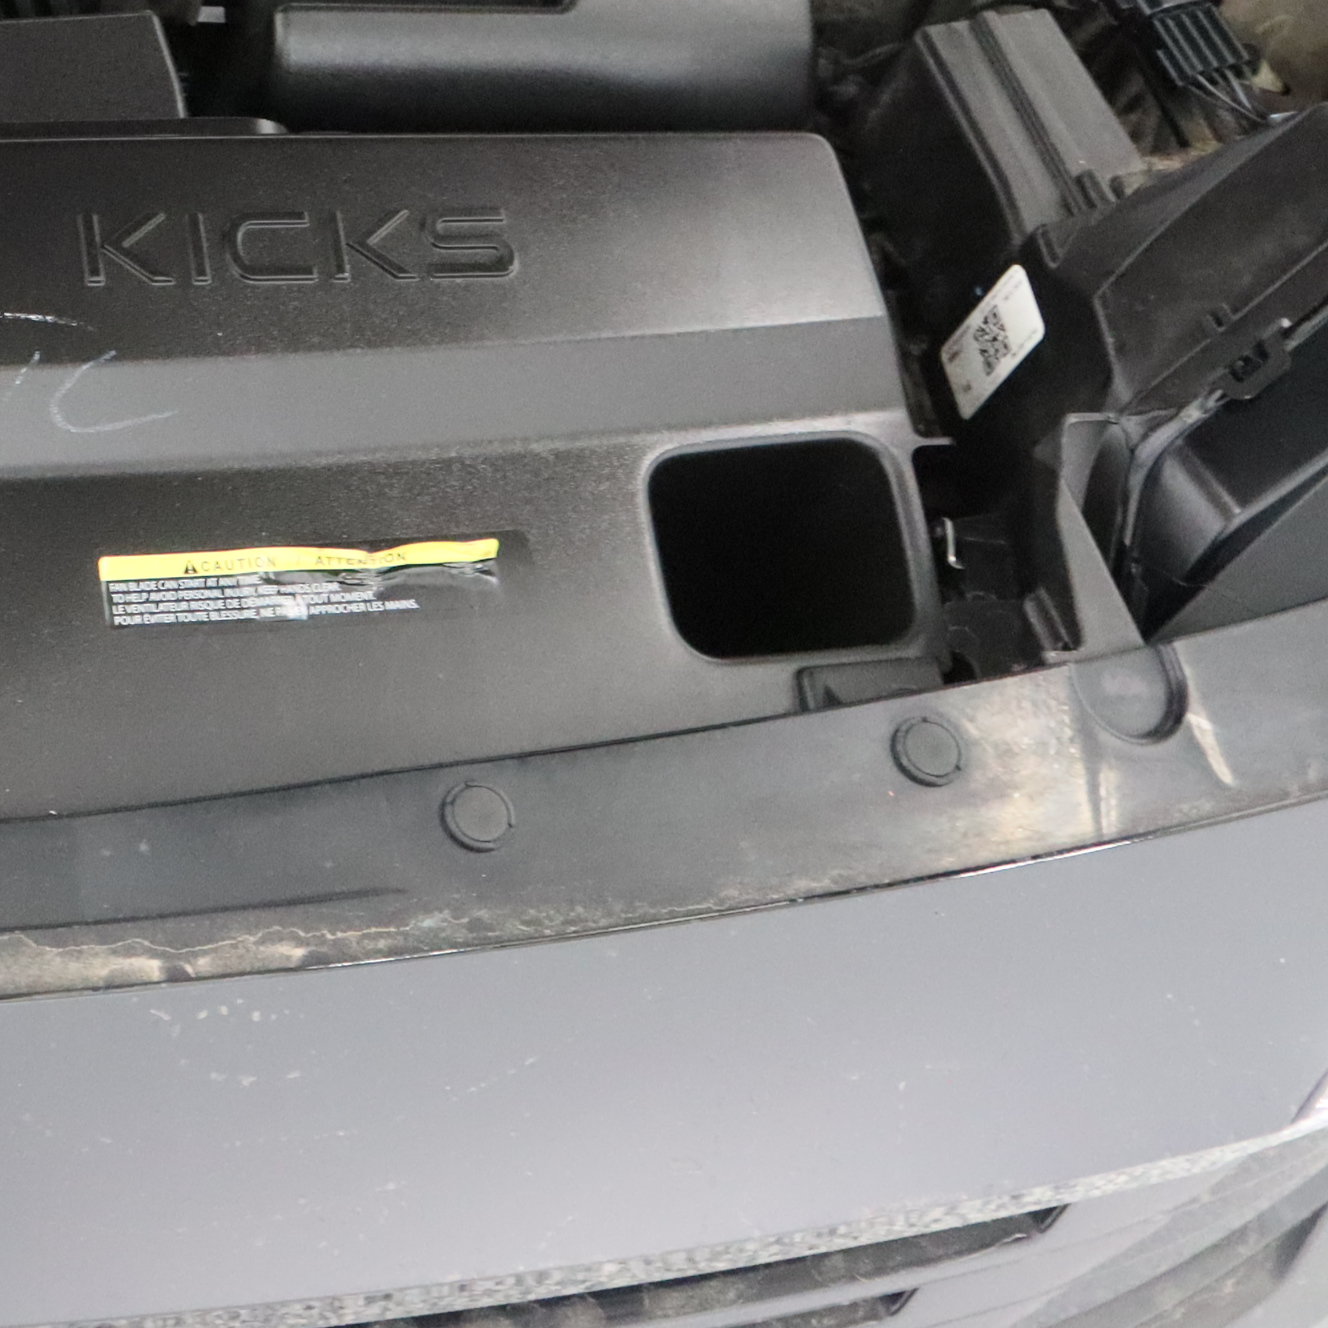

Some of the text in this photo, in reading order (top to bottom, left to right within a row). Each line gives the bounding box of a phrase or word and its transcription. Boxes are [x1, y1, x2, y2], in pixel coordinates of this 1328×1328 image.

[77, 208, 521, 288] KICKS
[201, 557, 277, 572] CAUTION
[314, 553, 406, 566] ATTENTION
[128, 580, 158, 591] BLADE
[158, 579, 179, 590] CAN
[178, 578, 206, 589] START
[111, 594, 125, 603] TO
[125, 592, 149, 603] HELP
[148, 591, 178, 602] AVOID
[177, 588, 223, 600] PERSONAL
[112, 605, 125, 615] LE
[124, 601, 189, 614] VENTILATEUR
[189, 598, 226, 610] RISQUE
[225, 598, 241, 609] DE
[113, 615, 143, 626] POUR
[176, 611, 210, 623] TOUTE
[366, 599, 385, 612] LES
